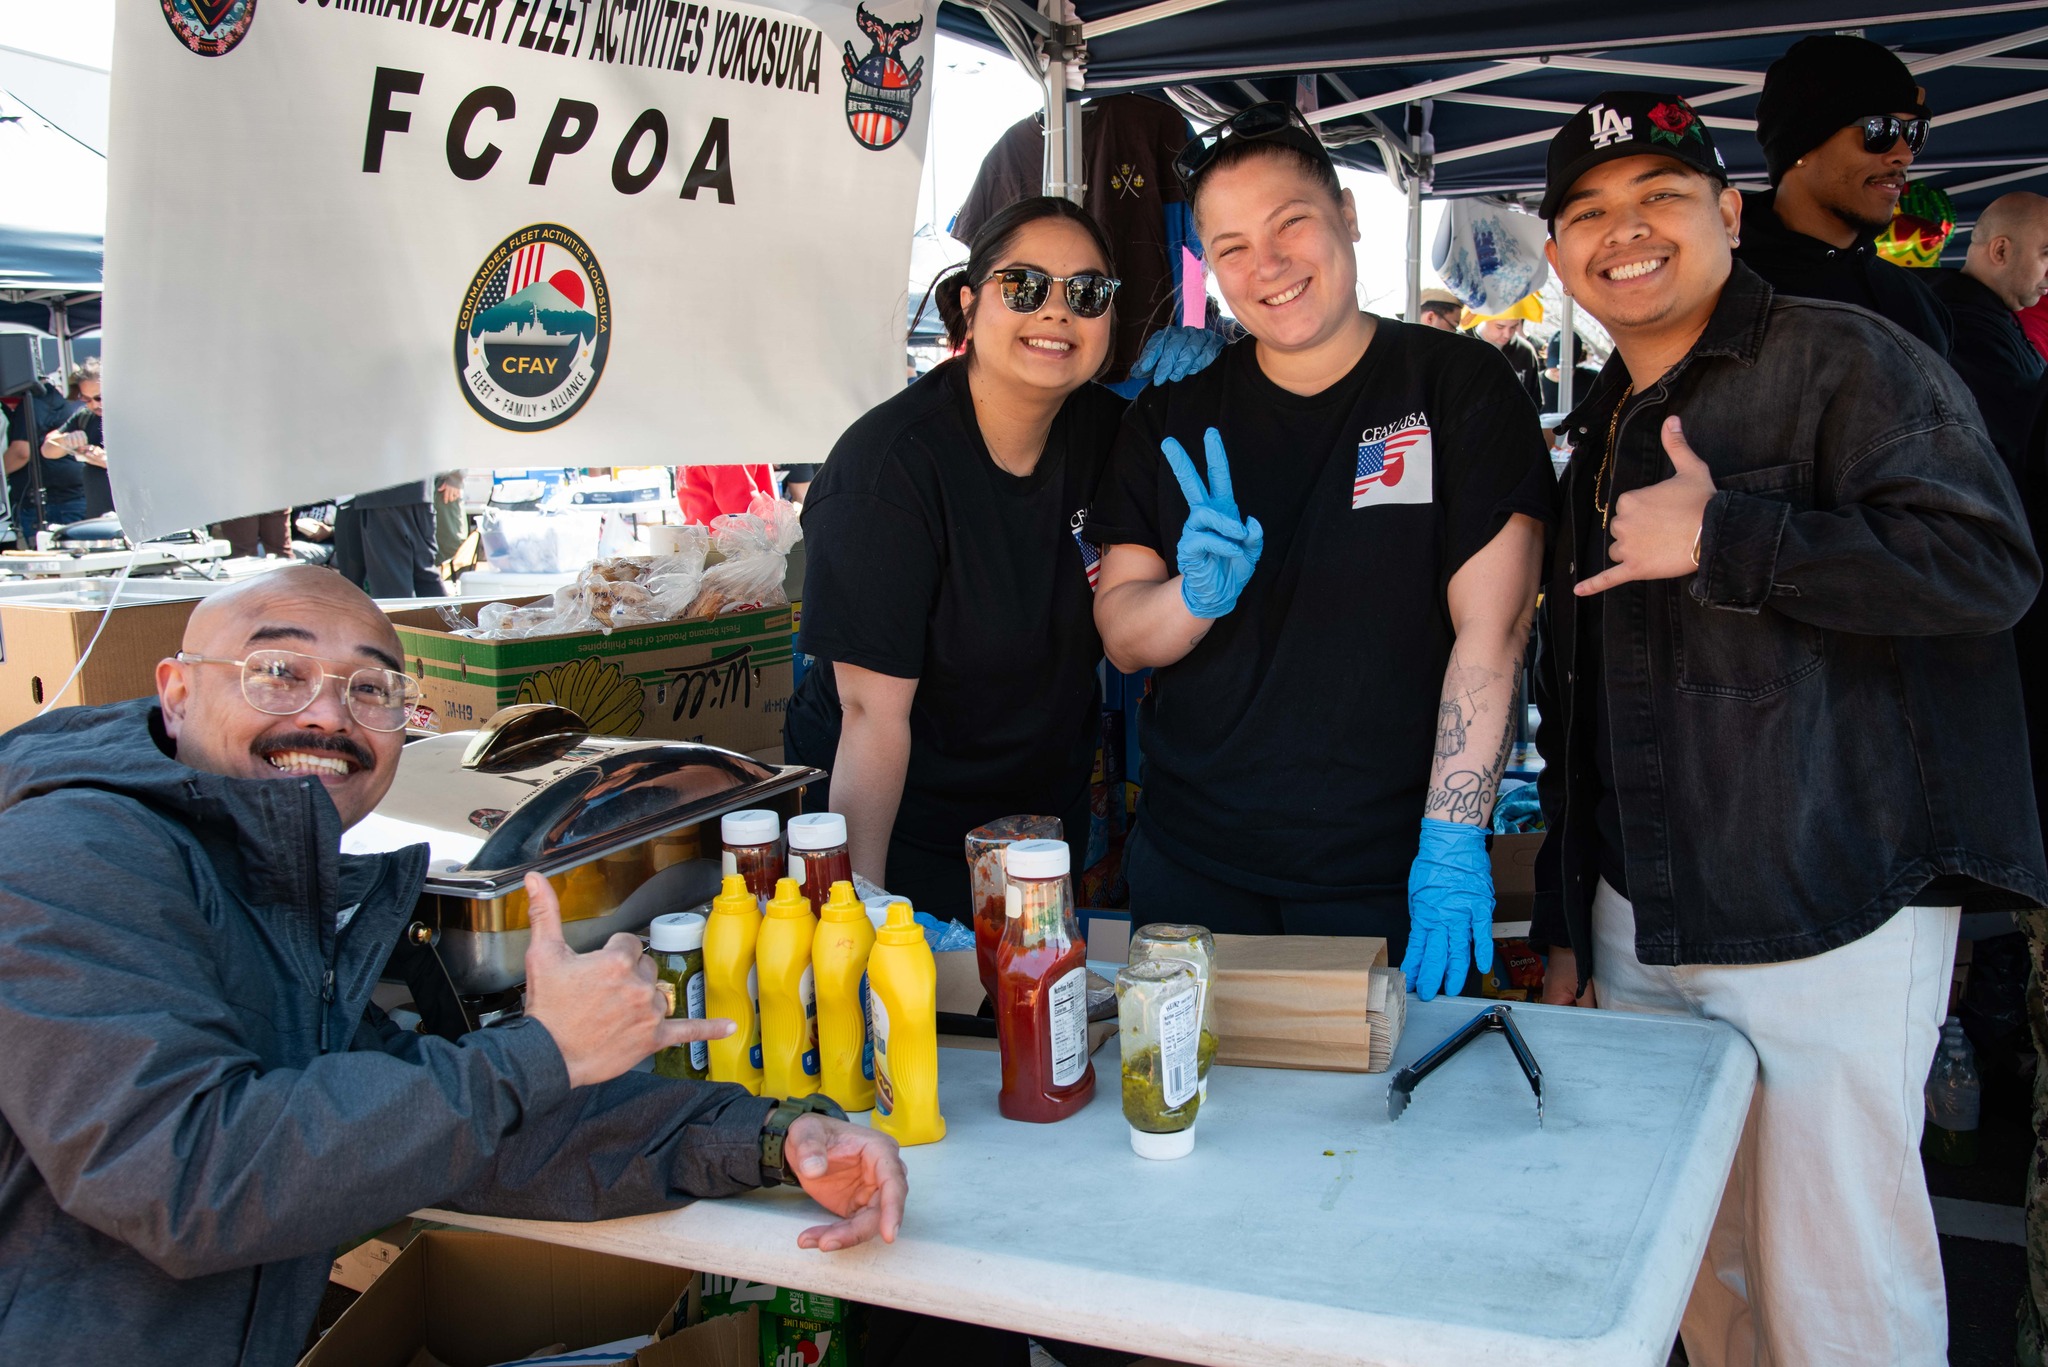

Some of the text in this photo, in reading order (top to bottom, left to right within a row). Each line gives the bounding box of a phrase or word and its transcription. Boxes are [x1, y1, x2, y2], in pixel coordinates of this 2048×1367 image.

[501, 0, 592, 57] FLEET
[588, 0, 709, 74] ACTIVITIES
[706, 9, 823, 94] YOKOSUKA
[1588, 103, 1633, 150] LA
[459, 229, 608, 334] COMMANDER FLEET ACTIVITIES YOKOSUKA
[502, 357, 558, 374] CFAY
[471, 370, 587, 417] FLEET FAMILY ALLIANCE
[1362, 411, 1428, 442] CFAY/JSA
[577, 624, 741, 652] Fresh Banana Product of the Philippines
[789, 1299, 806, 1314] 12
[783, 1317, 821, 1331] LEMON LIME
